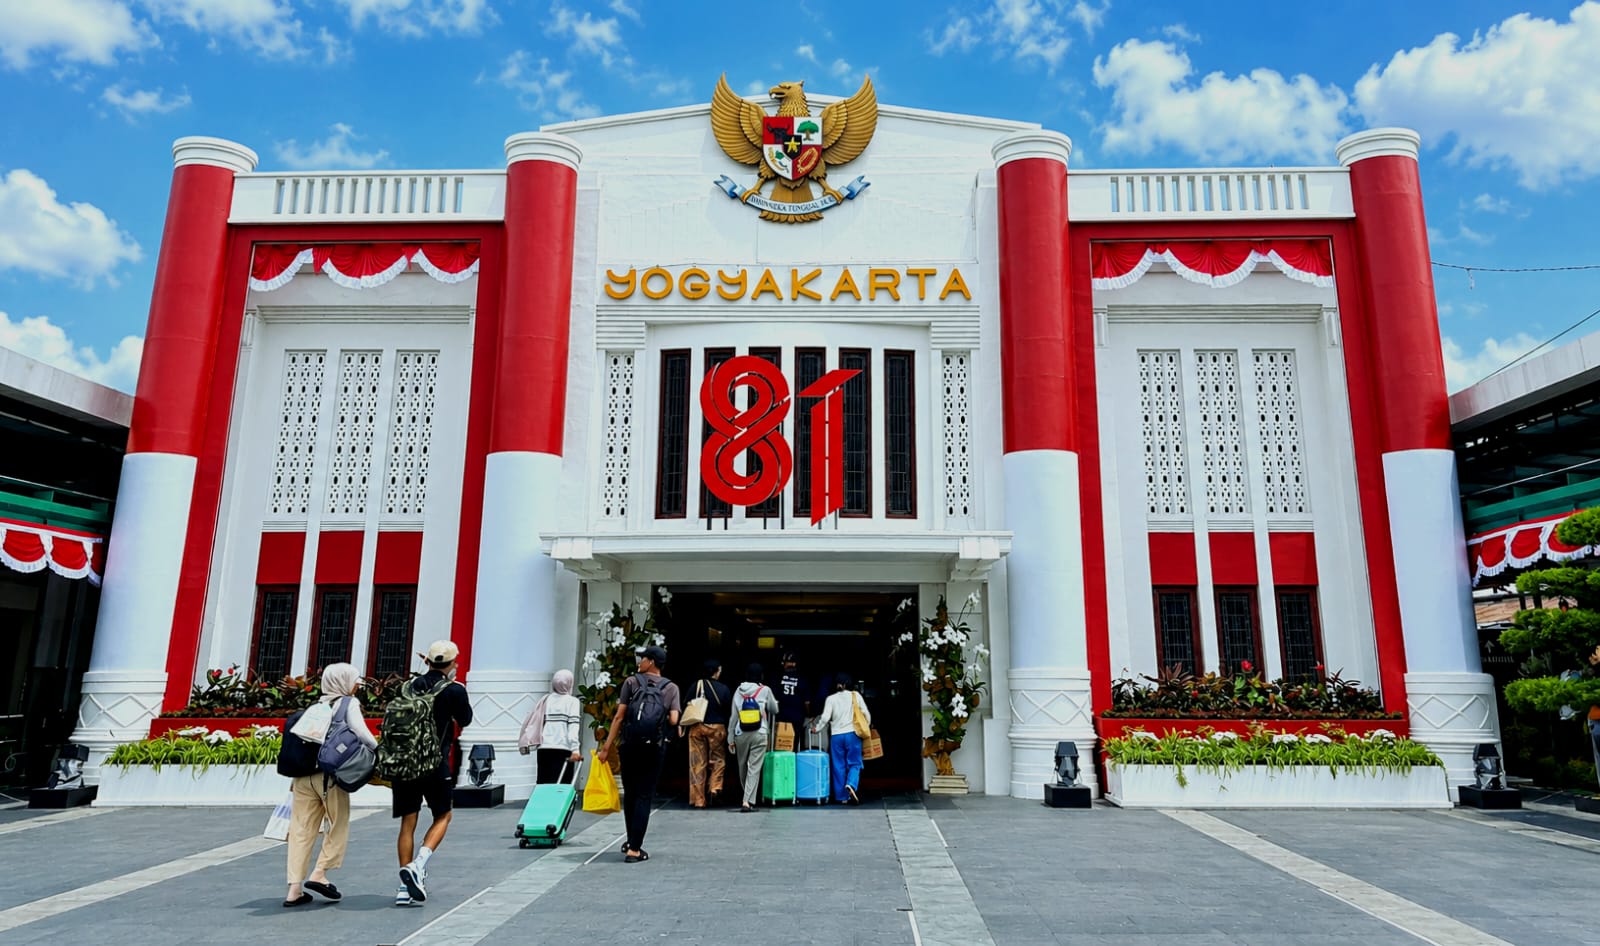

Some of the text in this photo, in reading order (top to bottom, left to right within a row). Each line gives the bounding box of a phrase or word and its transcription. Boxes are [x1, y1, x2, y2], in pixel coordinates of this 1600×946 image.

[604, 268, 972, 300] YOGYAKARTA
[700, 355, 863, 527] 81
[783, 685, 795, 696] 51
